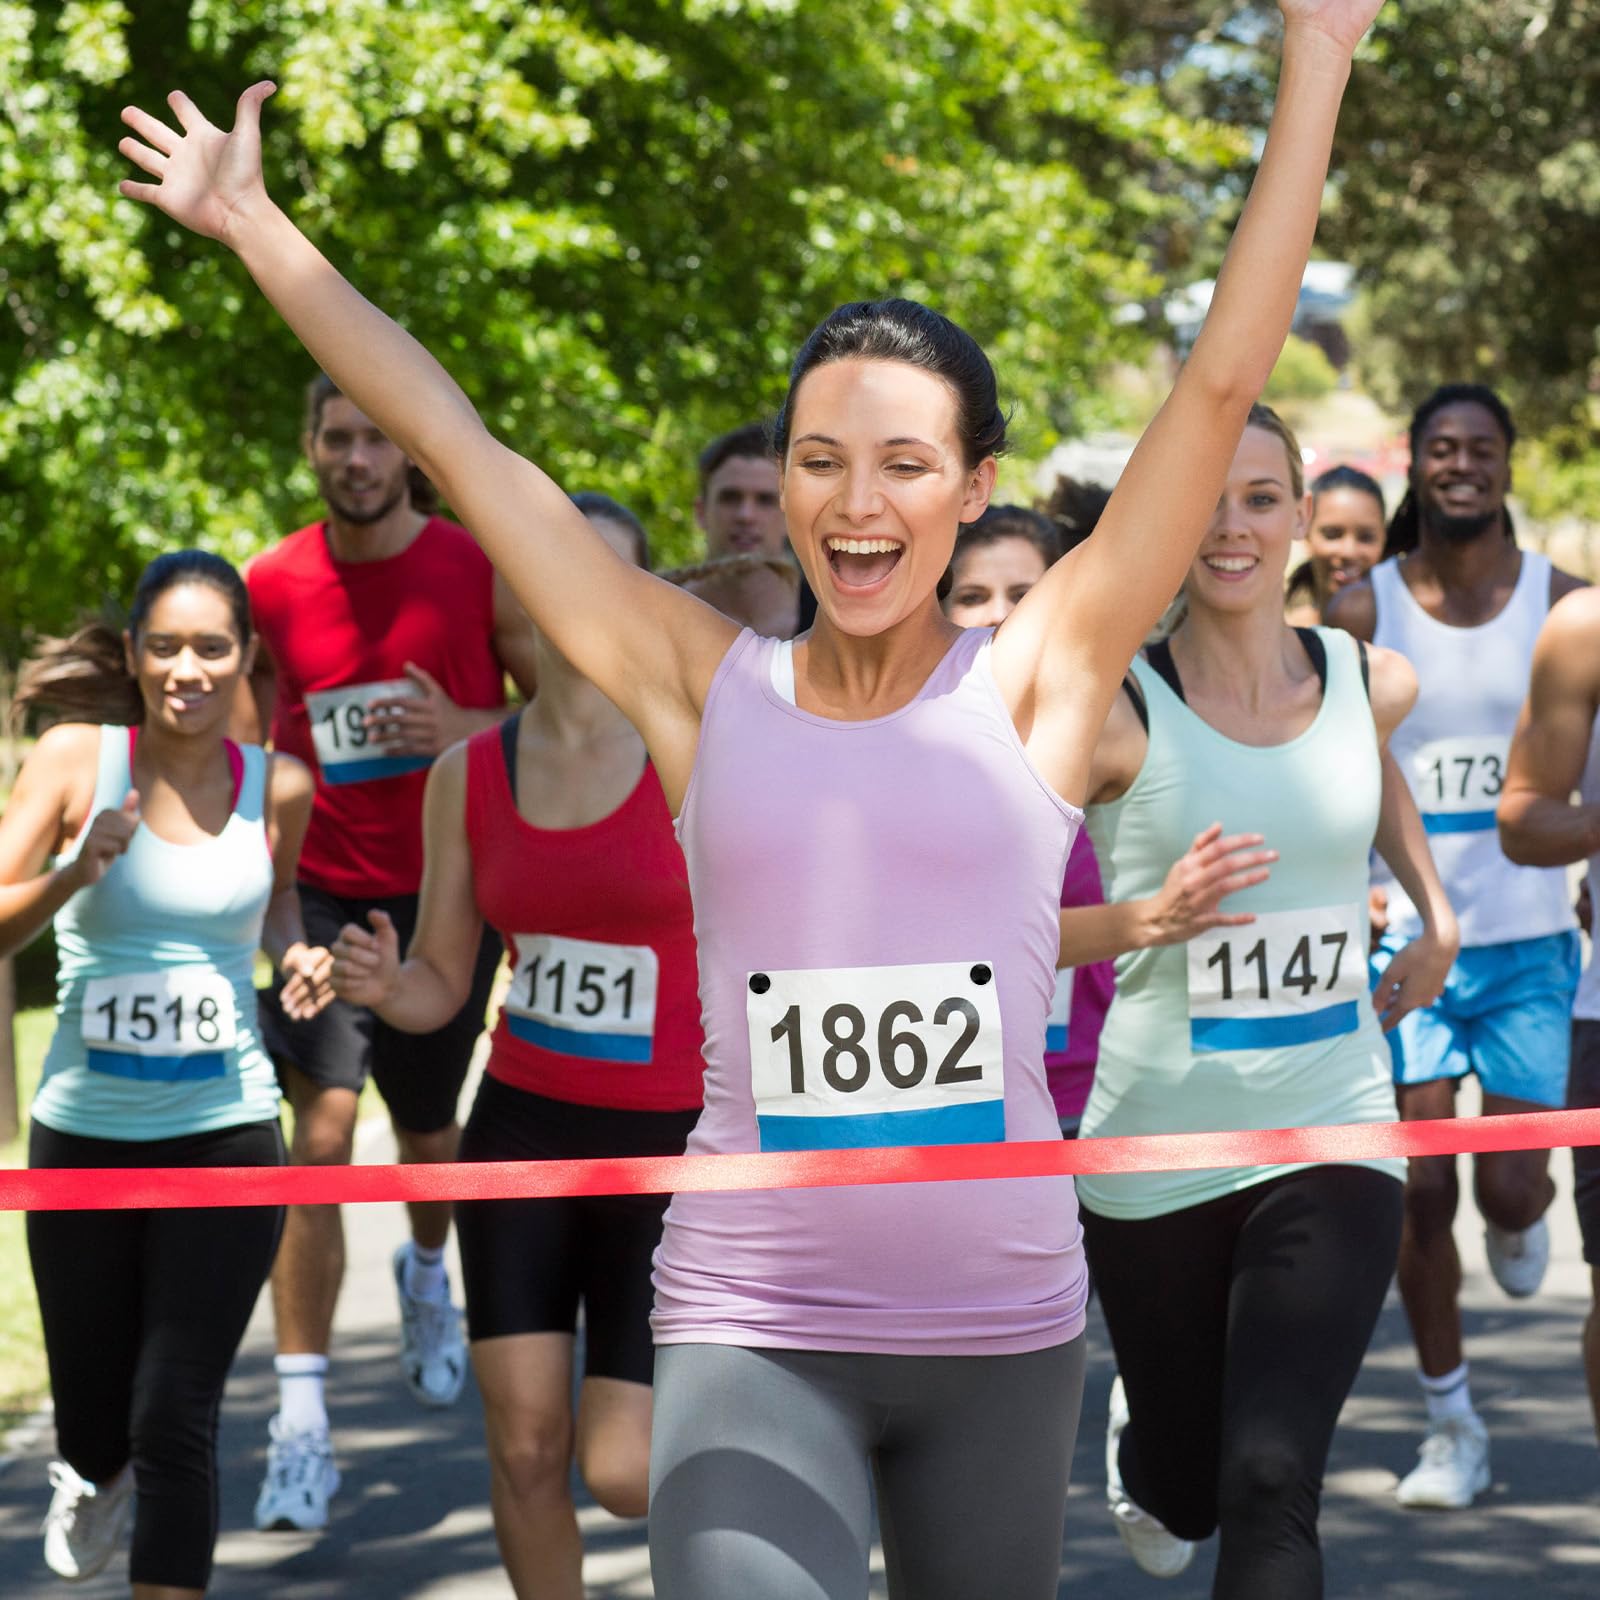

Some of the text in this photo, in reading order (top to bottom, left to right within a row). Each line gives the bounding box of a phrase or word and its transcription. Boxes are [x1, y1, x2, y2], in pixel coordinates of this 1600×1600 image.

[524, 955, 634, 1030] 1151
[1207, 931, 1348, 1000] 1147
[97, 994, 219, 1043] 1518
[770, 996, 983, 1094] 1862
